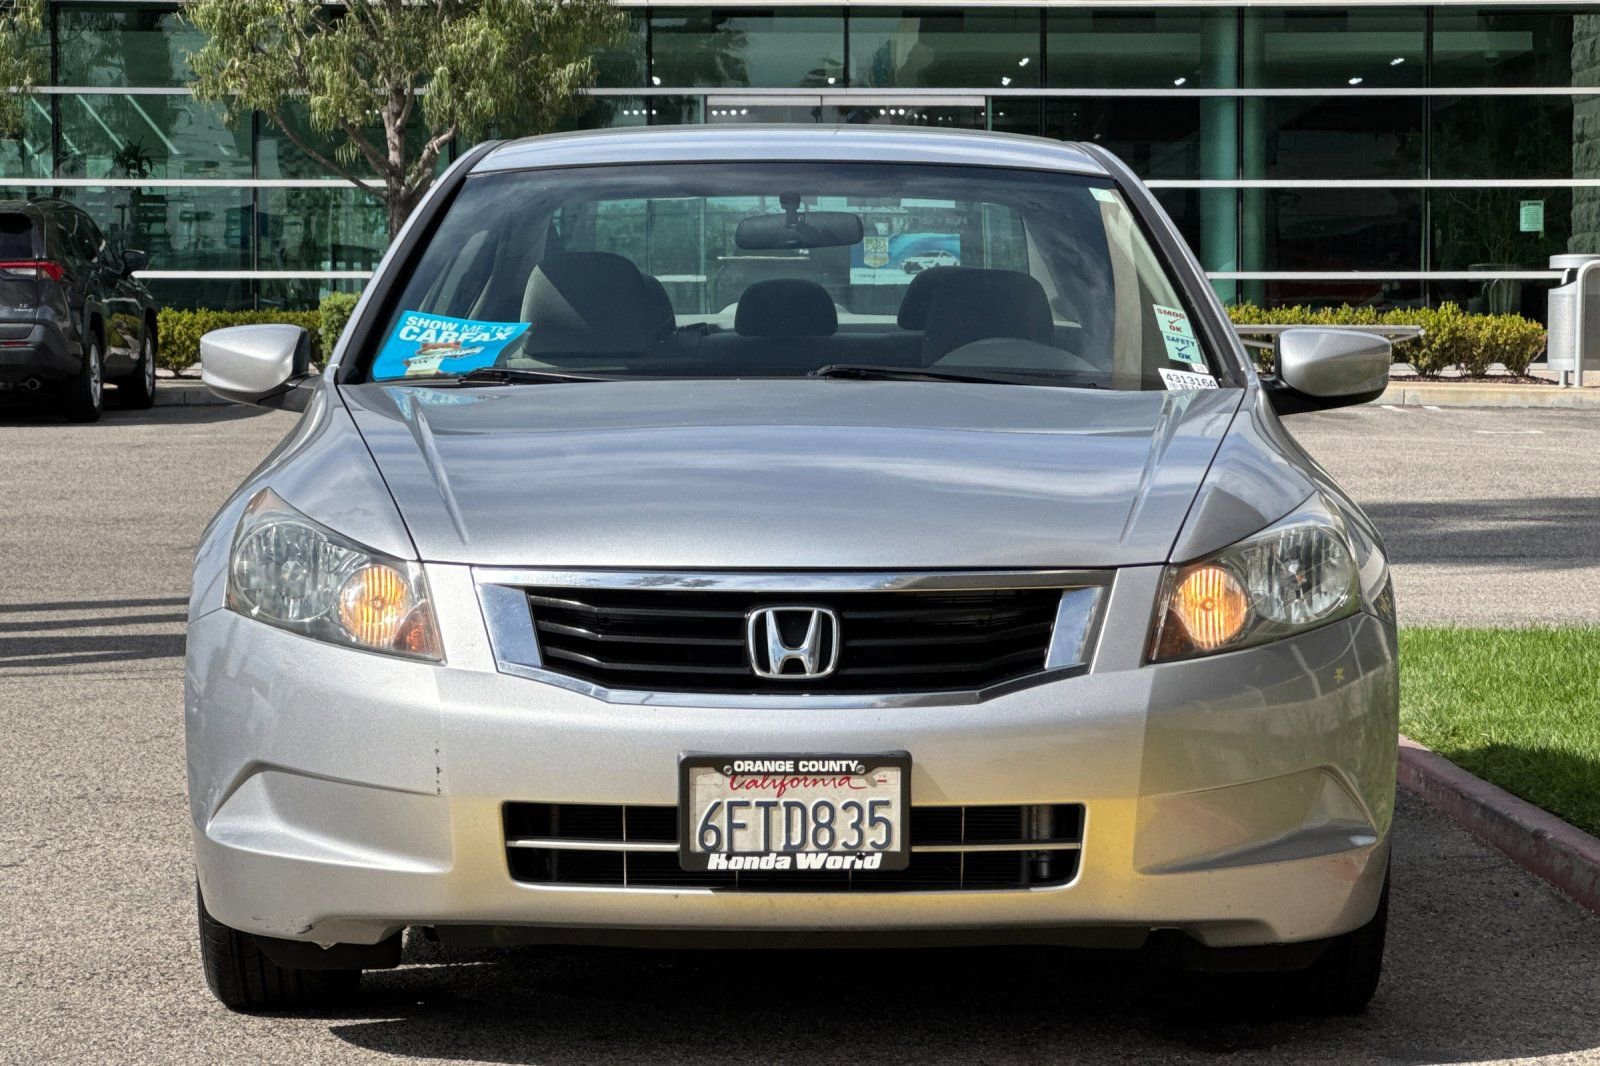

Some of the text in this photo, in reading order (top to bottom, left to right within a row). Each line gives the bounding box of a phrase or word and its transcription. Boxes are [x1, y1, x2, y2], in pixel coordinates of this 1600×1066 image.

[1157, 308, 1186, 319] SMOG
[405, 316, 517, 334] SHOW ME THE
[399, 325, 513, 344] CARFAX
[1165, 335, 1195, 347] SAFETY
[1177, 352, 1192, 360] OK
[1166, 373, 1217, 388] 431316A
[733, 760, 859, 773] ORANGE COUNTY
[729, 774, 867, 798] California
[699, 800, 893, 851] 6FTD835
[707, 852, 882, 870] Honda World
